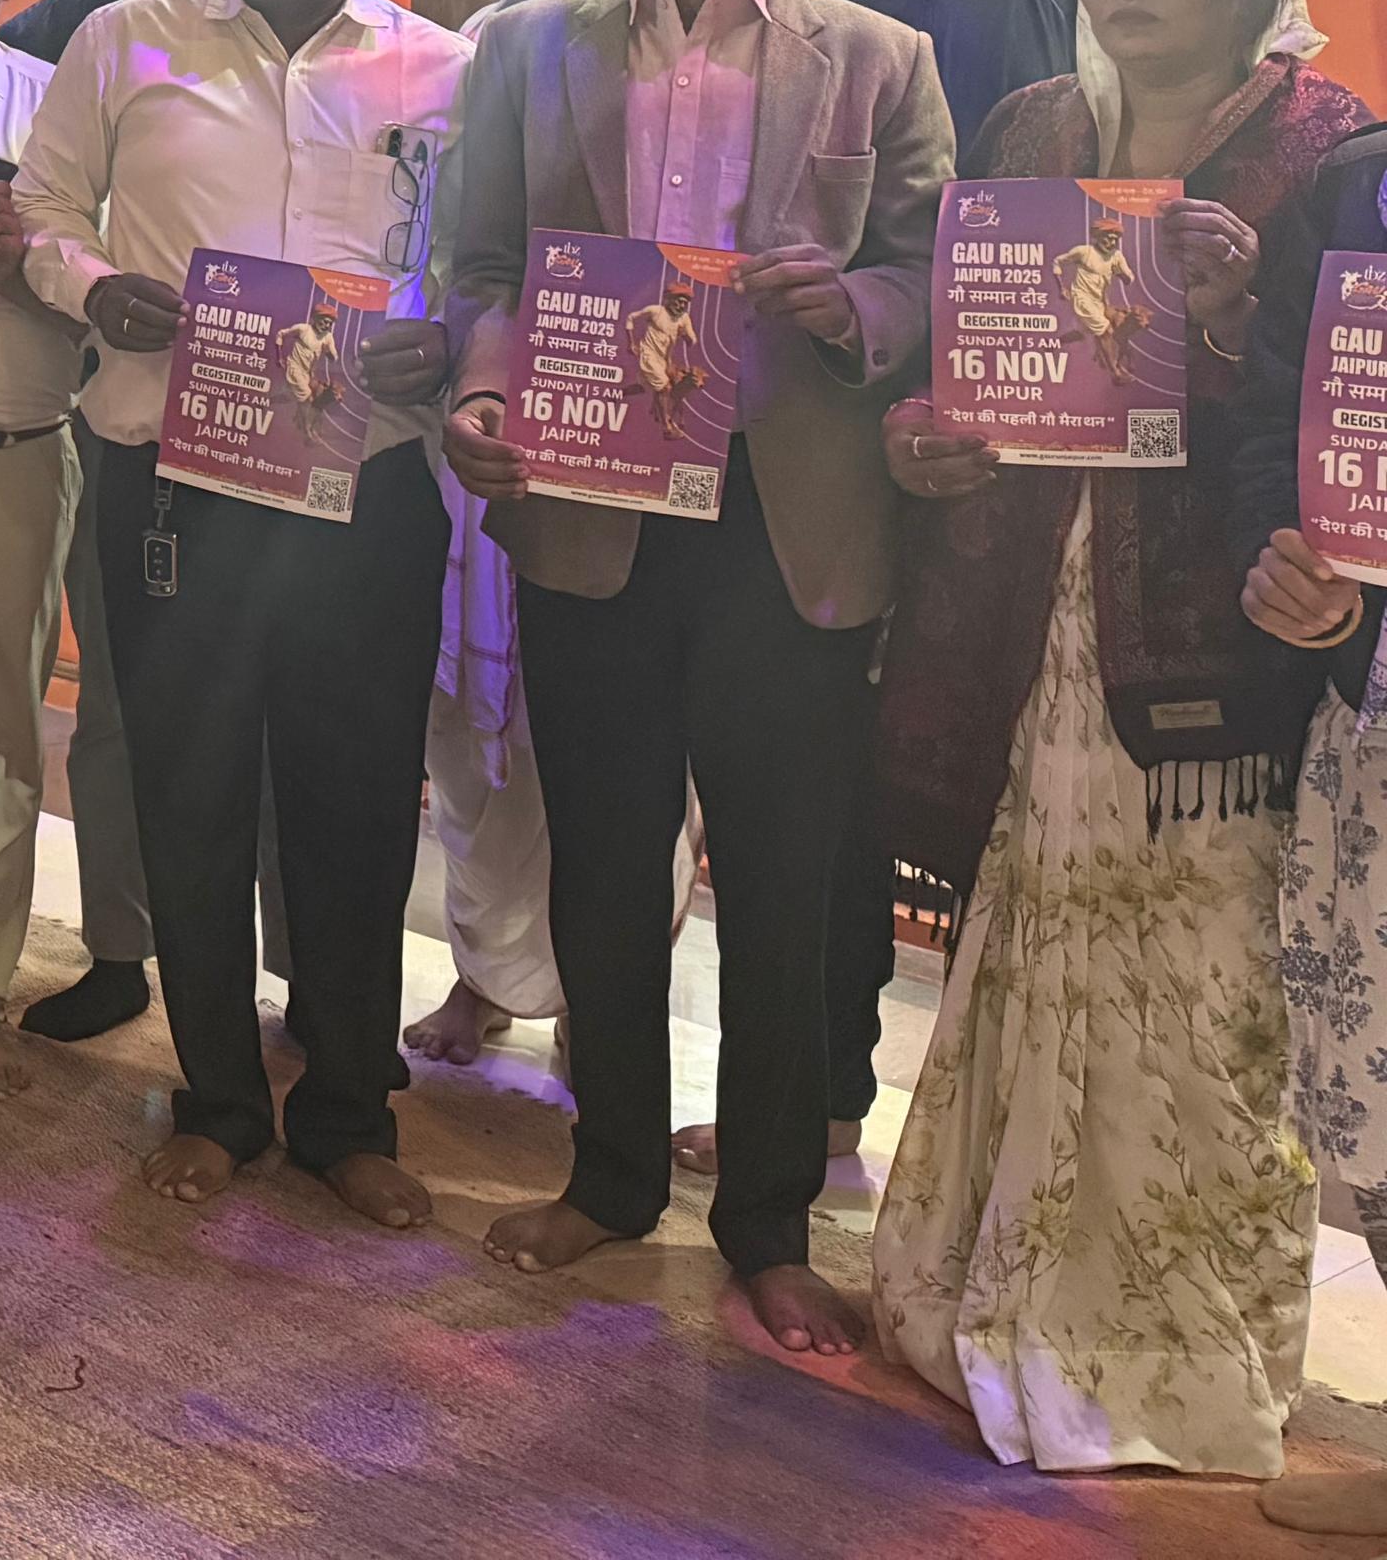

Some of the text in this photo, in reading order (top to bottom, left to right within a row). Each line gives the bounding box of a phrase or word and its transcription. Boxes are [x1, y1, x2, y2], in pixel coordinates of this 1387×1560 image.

[952, 242, 1044, 265] GAU RUN
[953, 267, 1041, 285] JAIPUR 2025
[537, 290, 621, 321] GAU RUN
[948, 288, 1048, 309] गौ सम्मान दौड़
[195, 303, 272, 336] GAU RUN
[536, 313, 615, 337] JAIPUR 2025
[964, 315, 1050, 329] REGISTER NOW
[529, 330, 618, 360] गौ सम्मान दौड़
[956, 335, 1061, 349] SUNDAY 5 AM
[1330, 325, 1383, 355] GAU
[539, 359, 617, 379] REGISTER NOW
[948, 349, 1068, 383] 16 NOV
[1331, 356, 1387, 377] JAIPUR
[531, 377, 623, 400] SUNDAY 5 AM
[975, 384, 1043, 401] JAIPUR
[1322, 376, 1345, 397] गौ
[180, 391, 274, 436] 16 NOV
[521, 390, 627, 432] 16 NOV
[977, 409, 995, 424] की
[1000, 410, 1036, 427] पहली
[1040, 412, 1056, 427] गौ
[1341, 412, 1387, 428] REGIST
[195, 423, 249, 447] JAIPUR
[540, 425, 601, 447] JAIPUR
[1331, 434, 1387, 451] SUNDA
[540, 448, 556, 463] की
[594, 455, 608, 470] गौ
[1318, 449, 1363, 487] 16
[1349, 522, 1373, 538] की
